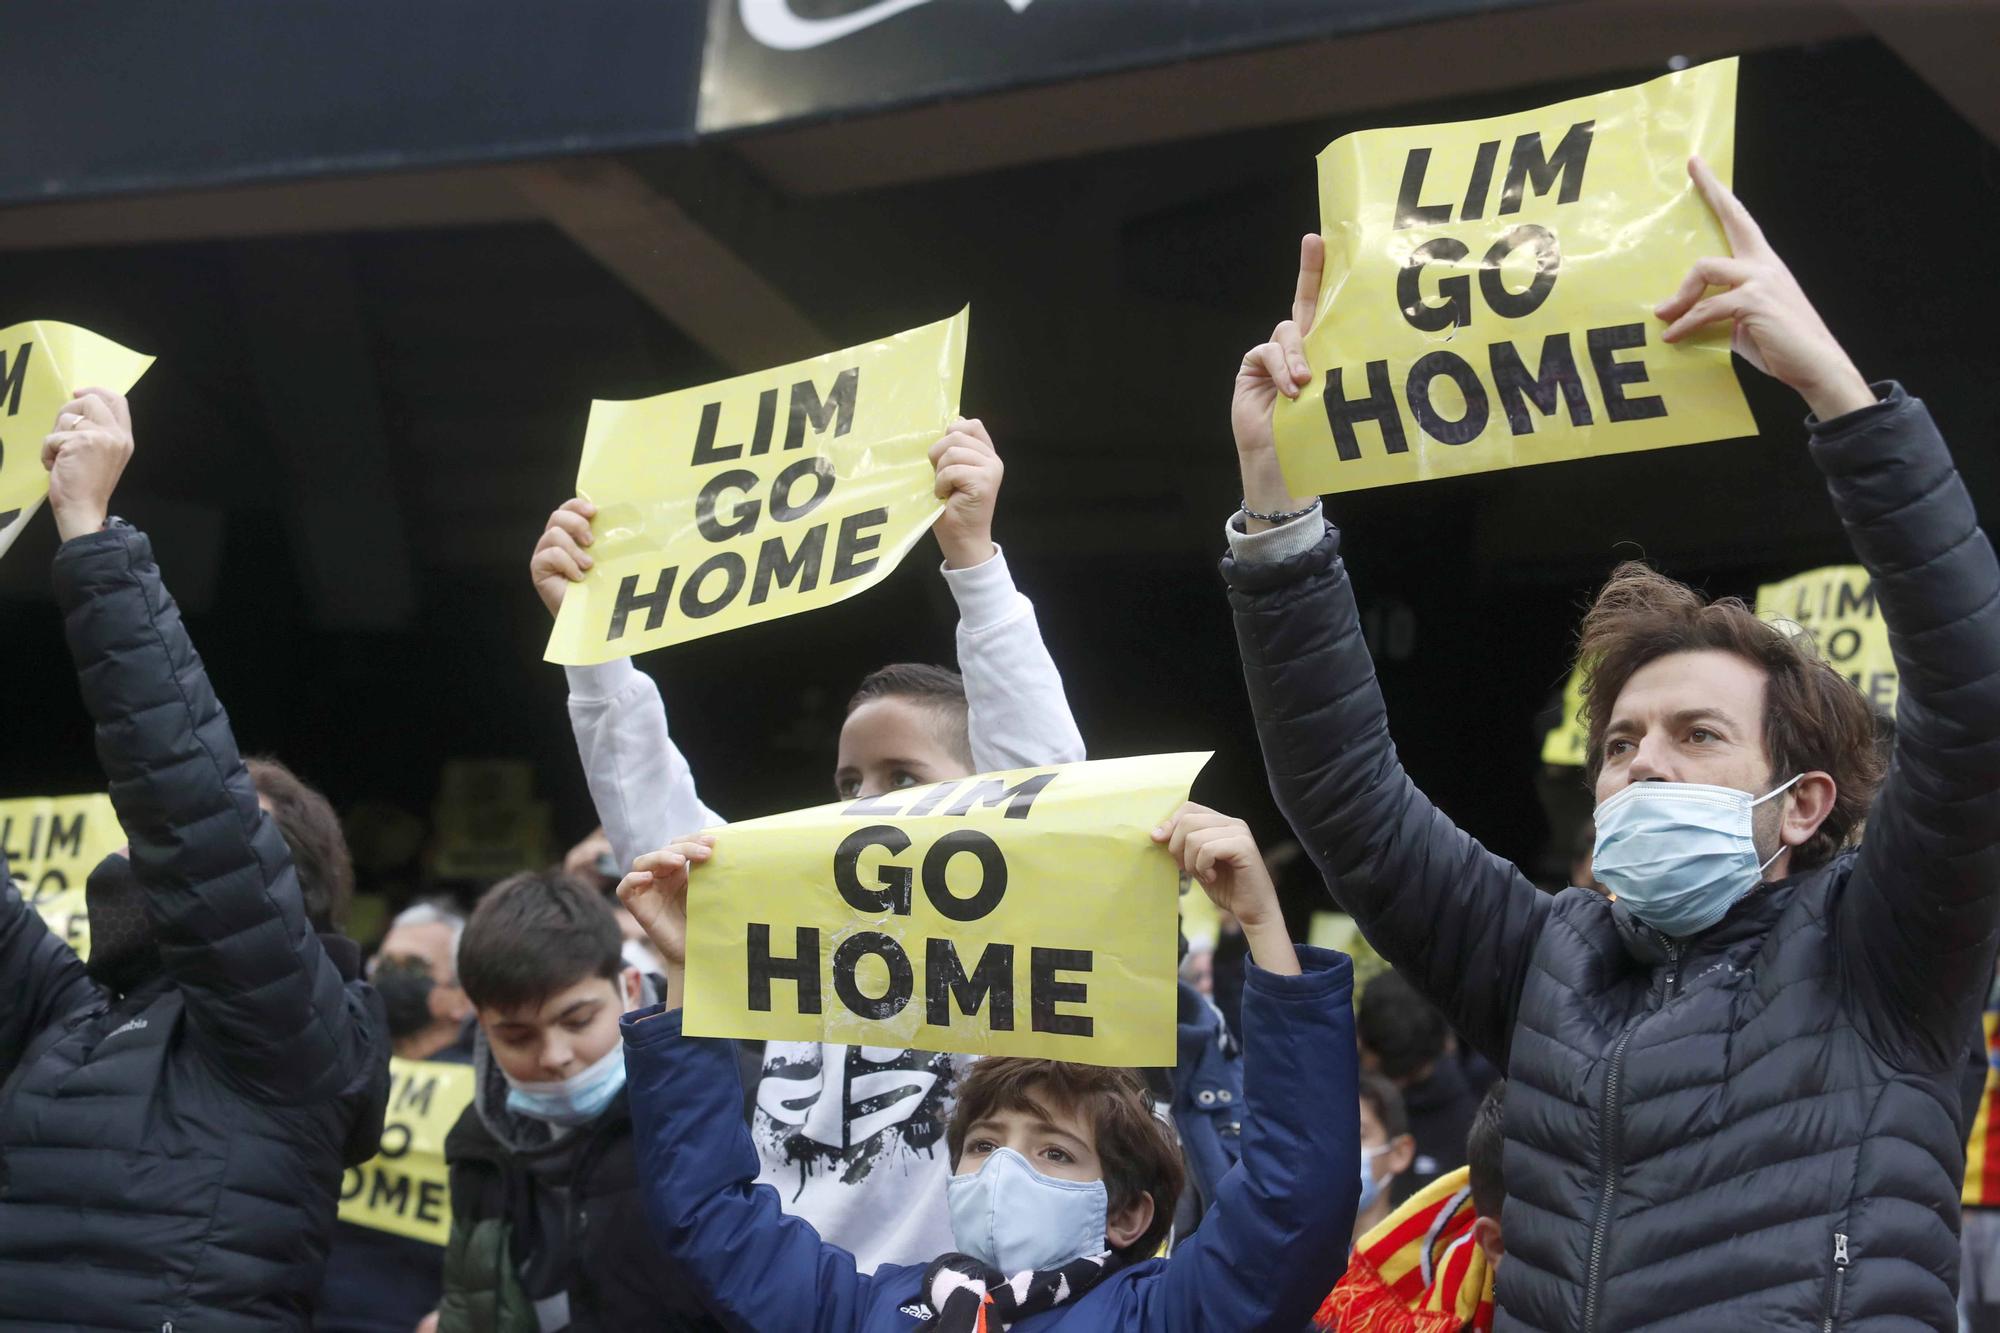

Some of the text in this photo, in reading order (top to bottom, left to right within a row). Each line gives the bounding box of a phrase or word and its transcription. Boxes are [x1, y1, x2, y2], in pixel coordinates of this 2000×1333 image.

[1393, 119, 1596, 230] LIM
[1396, 223, 1561, 332] GO
[690, 366, 859, 466] LIM
[1323, 322, 1668, 461] HOME
[695, 456, 836, 543] GO
[606, 506, 889, 641] HOME
[1796, 581, 1875, 619] LIM
[840, 773, 1059, 819] LIM
[2, 811, 85, 860] LIM
[11, 870, 68, 903] O
[833, 824, 1008, 922] GO
[747, 922, 1093, 1037] HOME
[391, 1074, 438, 1117] M
[911, 1121, 930, 1136] TM
[341, 1166, 446, 1224] OME
[900, 1305, 933, 1320] adid
